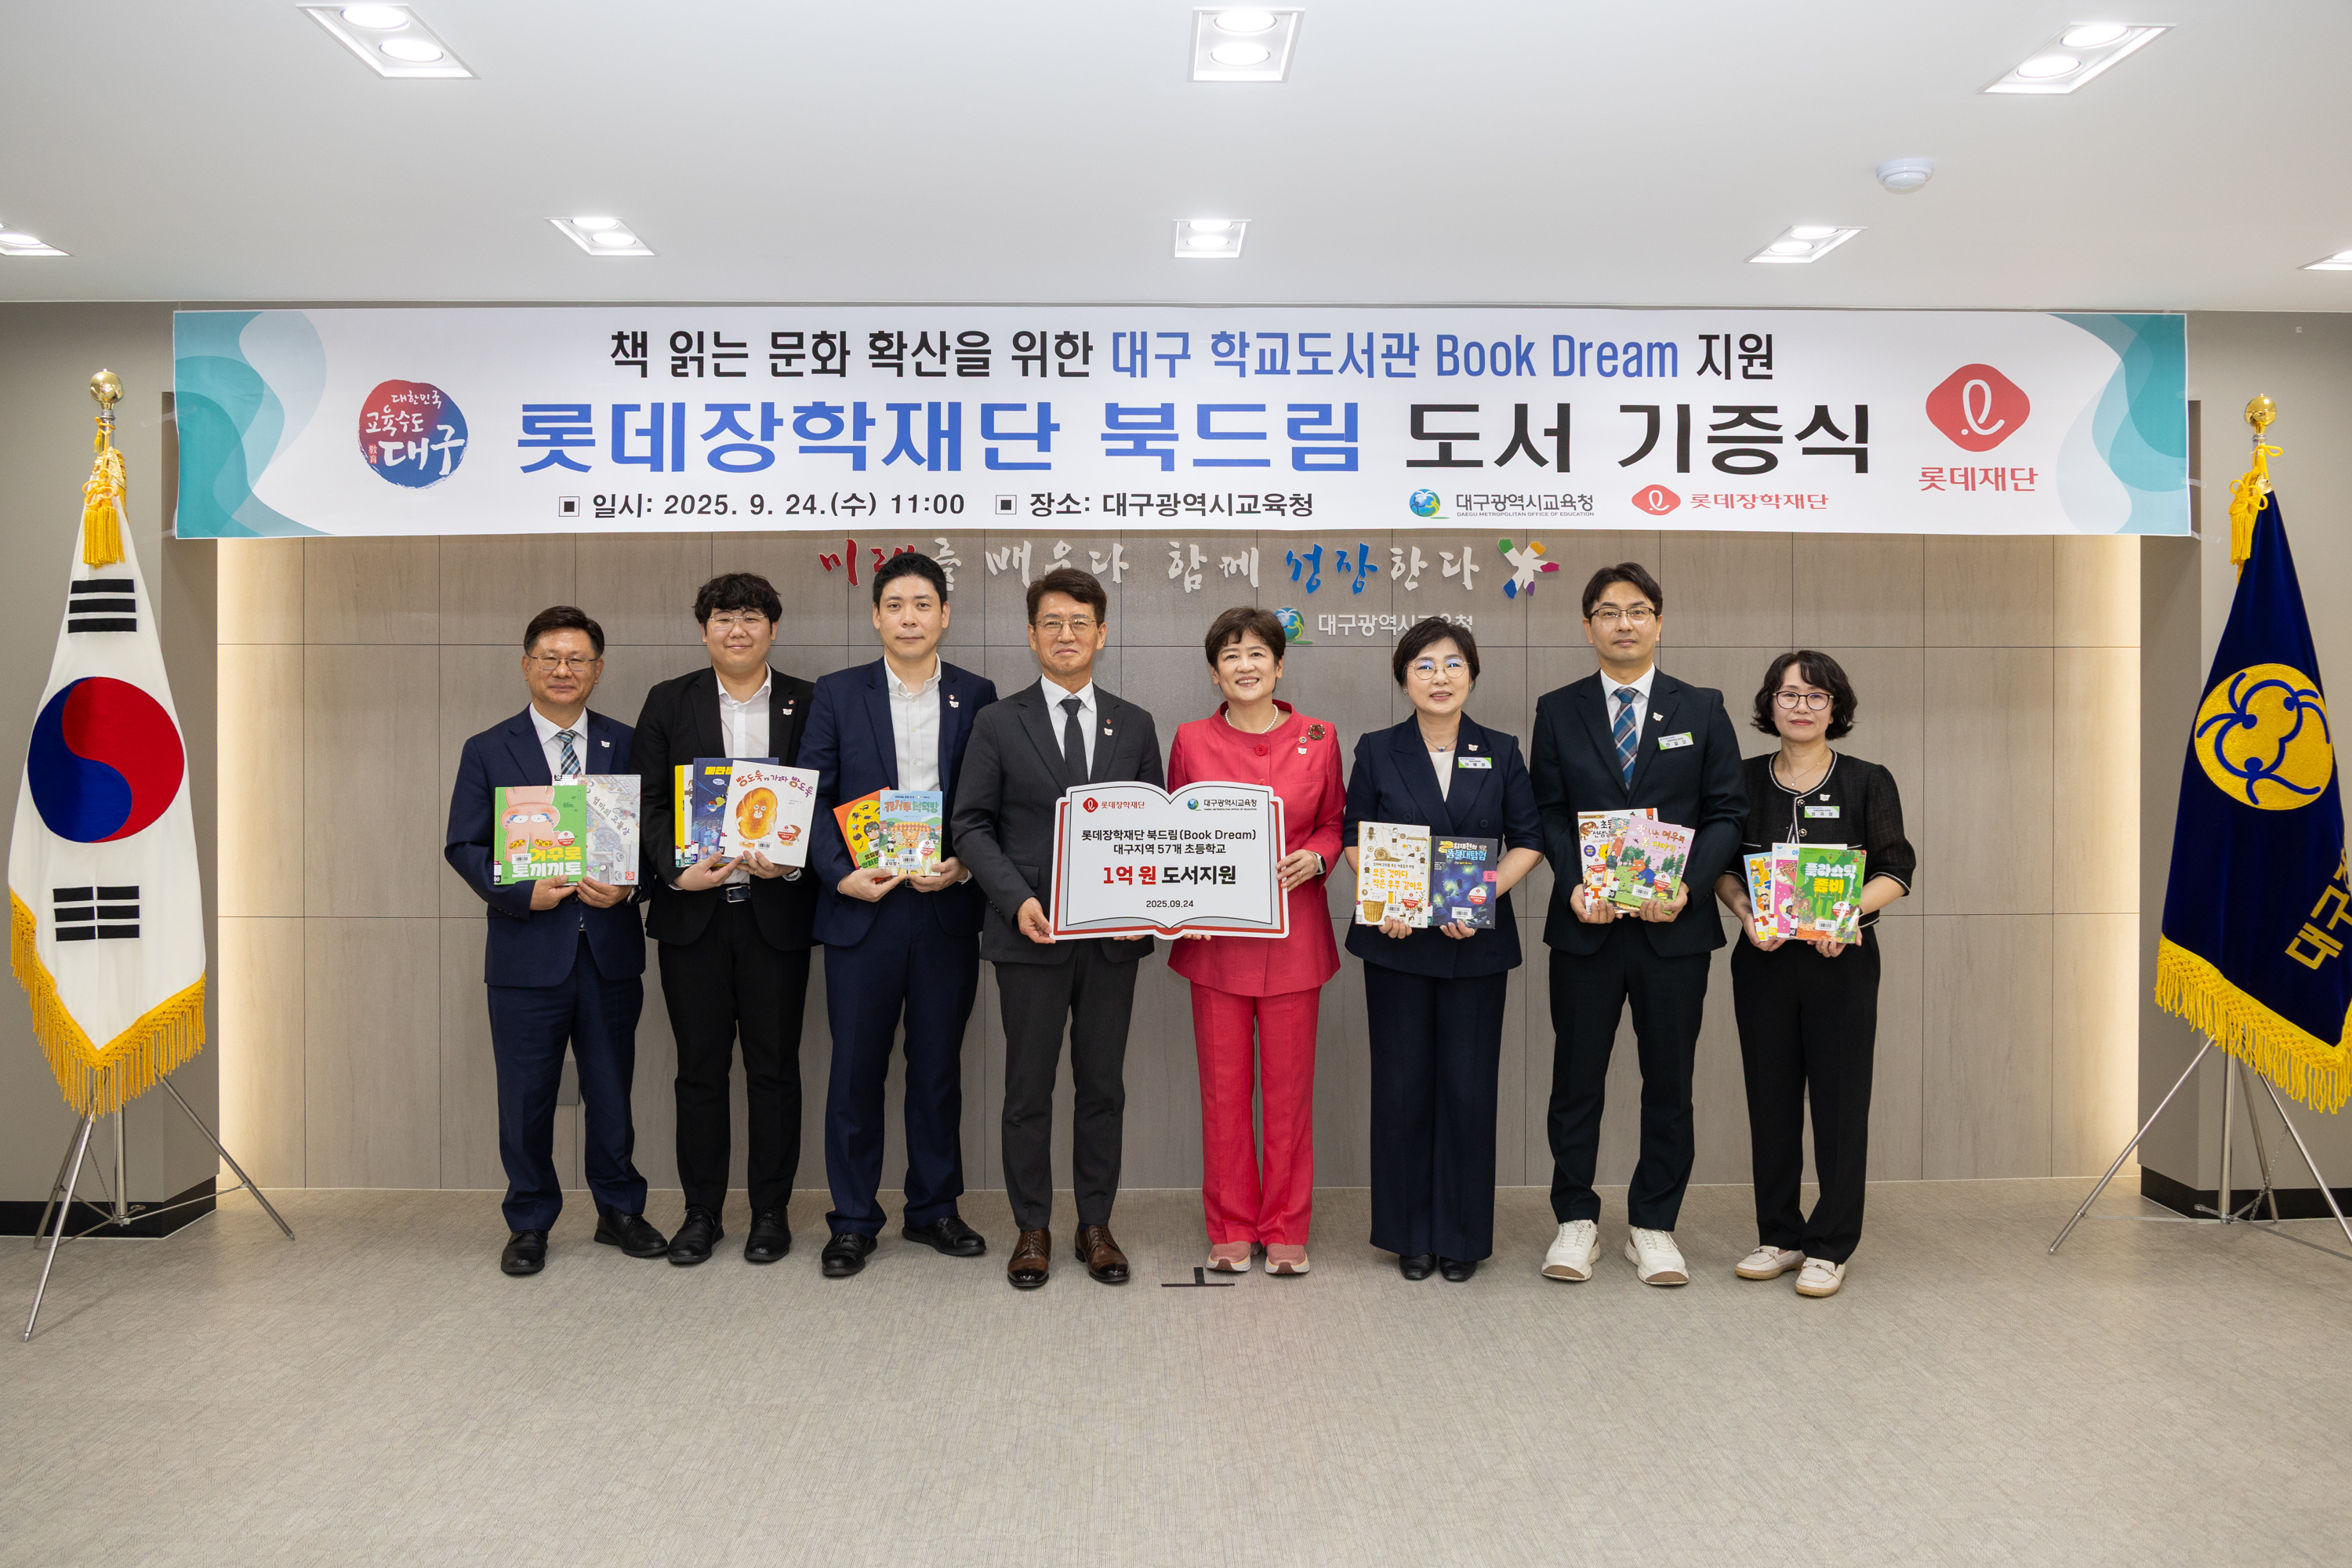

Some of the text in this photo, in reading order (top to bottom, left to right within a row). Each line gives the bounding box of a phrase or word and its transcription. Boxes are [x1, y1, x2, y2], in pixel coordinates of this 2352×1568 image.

[611, 331, 1773, 380] 책 읽는 문화 확산을 위한 대구 학교도서관 Book Dream 지원
[391, 390, 442, 409] 대한민국
[365, 405, 424, 437] 교육수도
[518, 401, 1869, 476] 롯데장학재단 북드림 도서 기증식
[378, 424, 466, 476] 대구
[1918, 466, 2038, 492] 롯데재단
[593, 492, 1313, 518] 일시: 2025. 9. 24.(수) 11:00 장소: 대구광역시교육청
[1456, 493, 1594, 512] 대구광역시교육청
[1690, 492, 1830, 511] 롯데장학재단
[1167, 541, 1259, 593] 함께
[593, 796, 612, 818] 엄마의
[1101, 800, 1145, 810] 롯데장학재단
[1203, 798, 1258, 808] 대구광역시교육청
[1081, 829, 1145, 841] 롯데장학재단
[1214, 829, 1257, 840] Dream)
[529, 846, 583, 862] 거꾸로
[1113, 843, 1227, 855] 대구지역 57개 초등학교
[1652, 840, 1676, 854] 이야기
[511, 862, 583, 878] 토끼끼토
[1103, 866, 1236, 886] 1억 원 도서지원
[1373, 868, 1409, 879] 모든 것마다
[1804, 862, 1857, 881] 플라스틱
[1373, 879, 1423, 891] 작은 우주 같아요
[1813, 877, 1845, 896] 좀비
[1146, 900, 1194, 909] 2025.09.24
